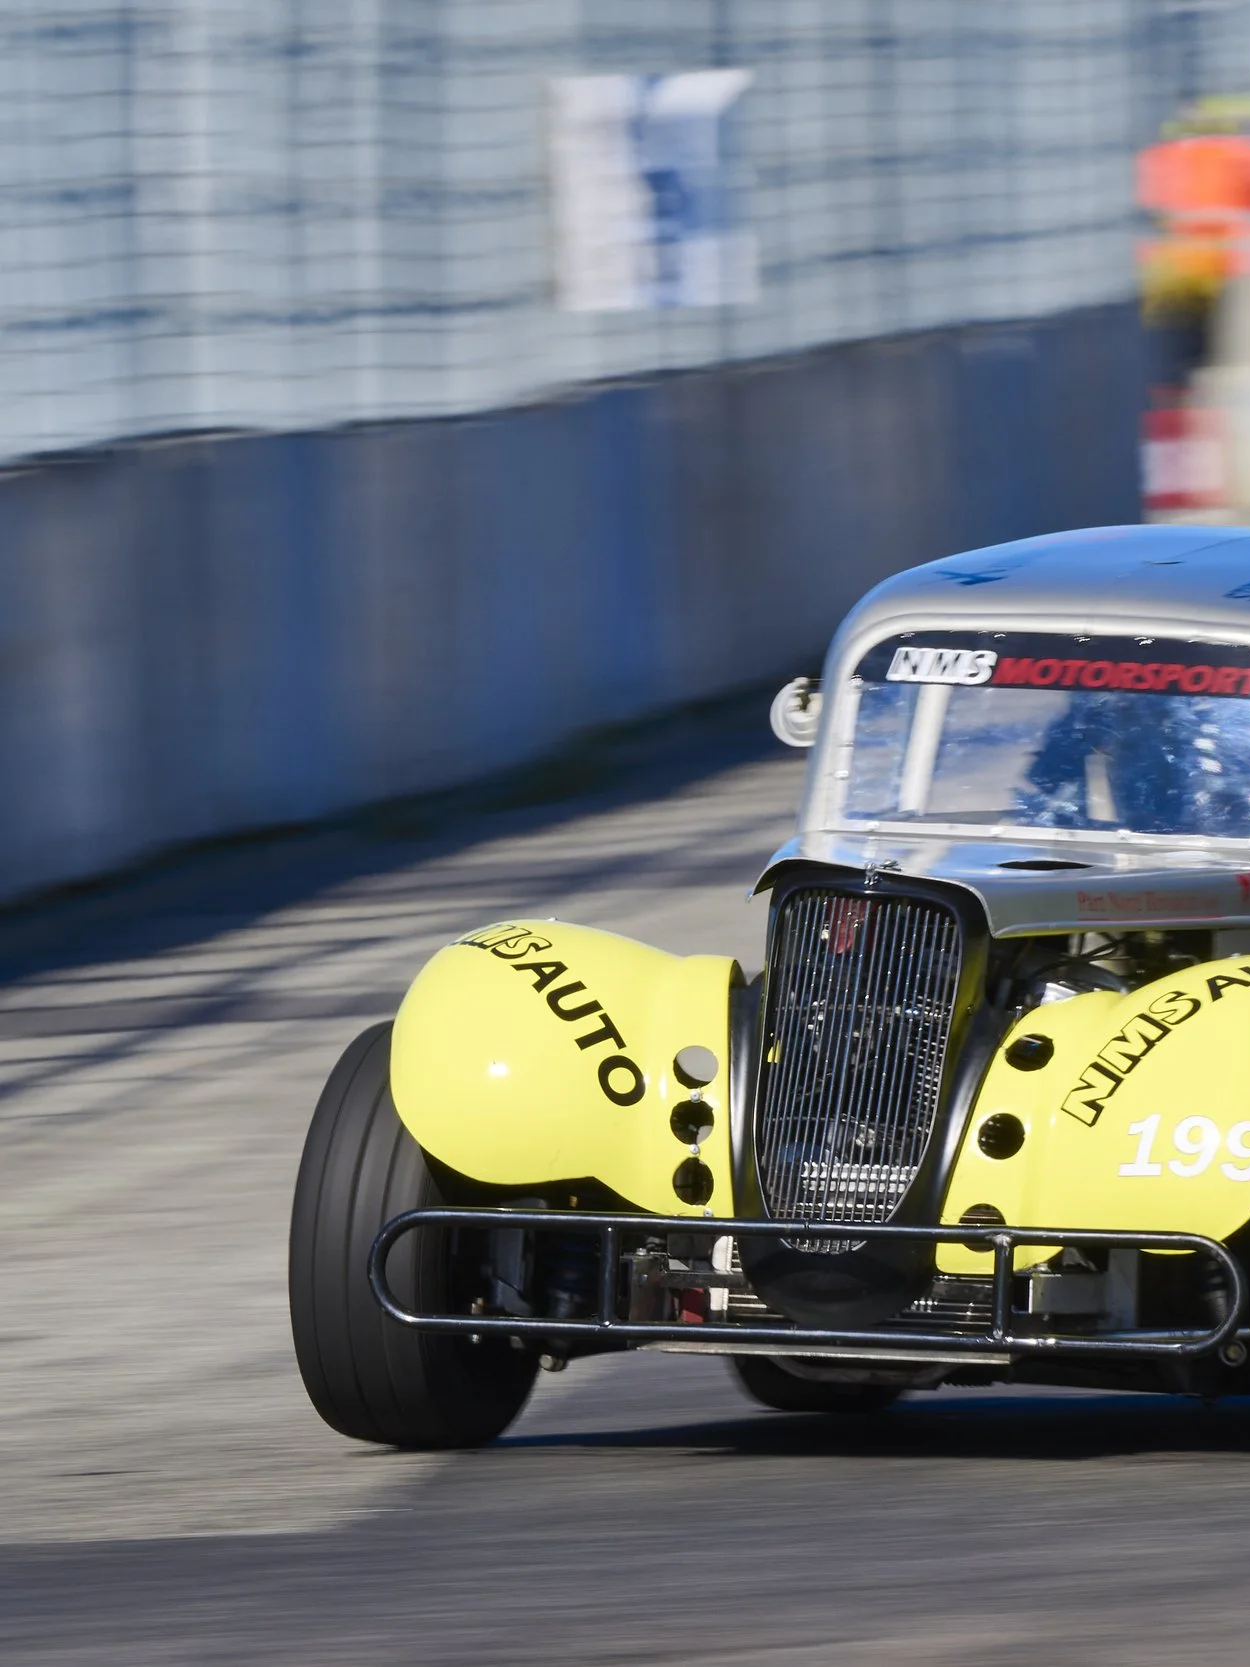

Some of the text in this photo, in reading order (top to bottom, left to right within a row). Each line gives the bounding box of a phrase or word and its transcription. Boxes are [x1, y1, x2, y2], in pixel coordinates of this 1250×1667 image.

[886, 647, 997, 685] NMS
[511, 961, 646, 1106] AUTO
[1061, 991, 1201, 1127] NMS
